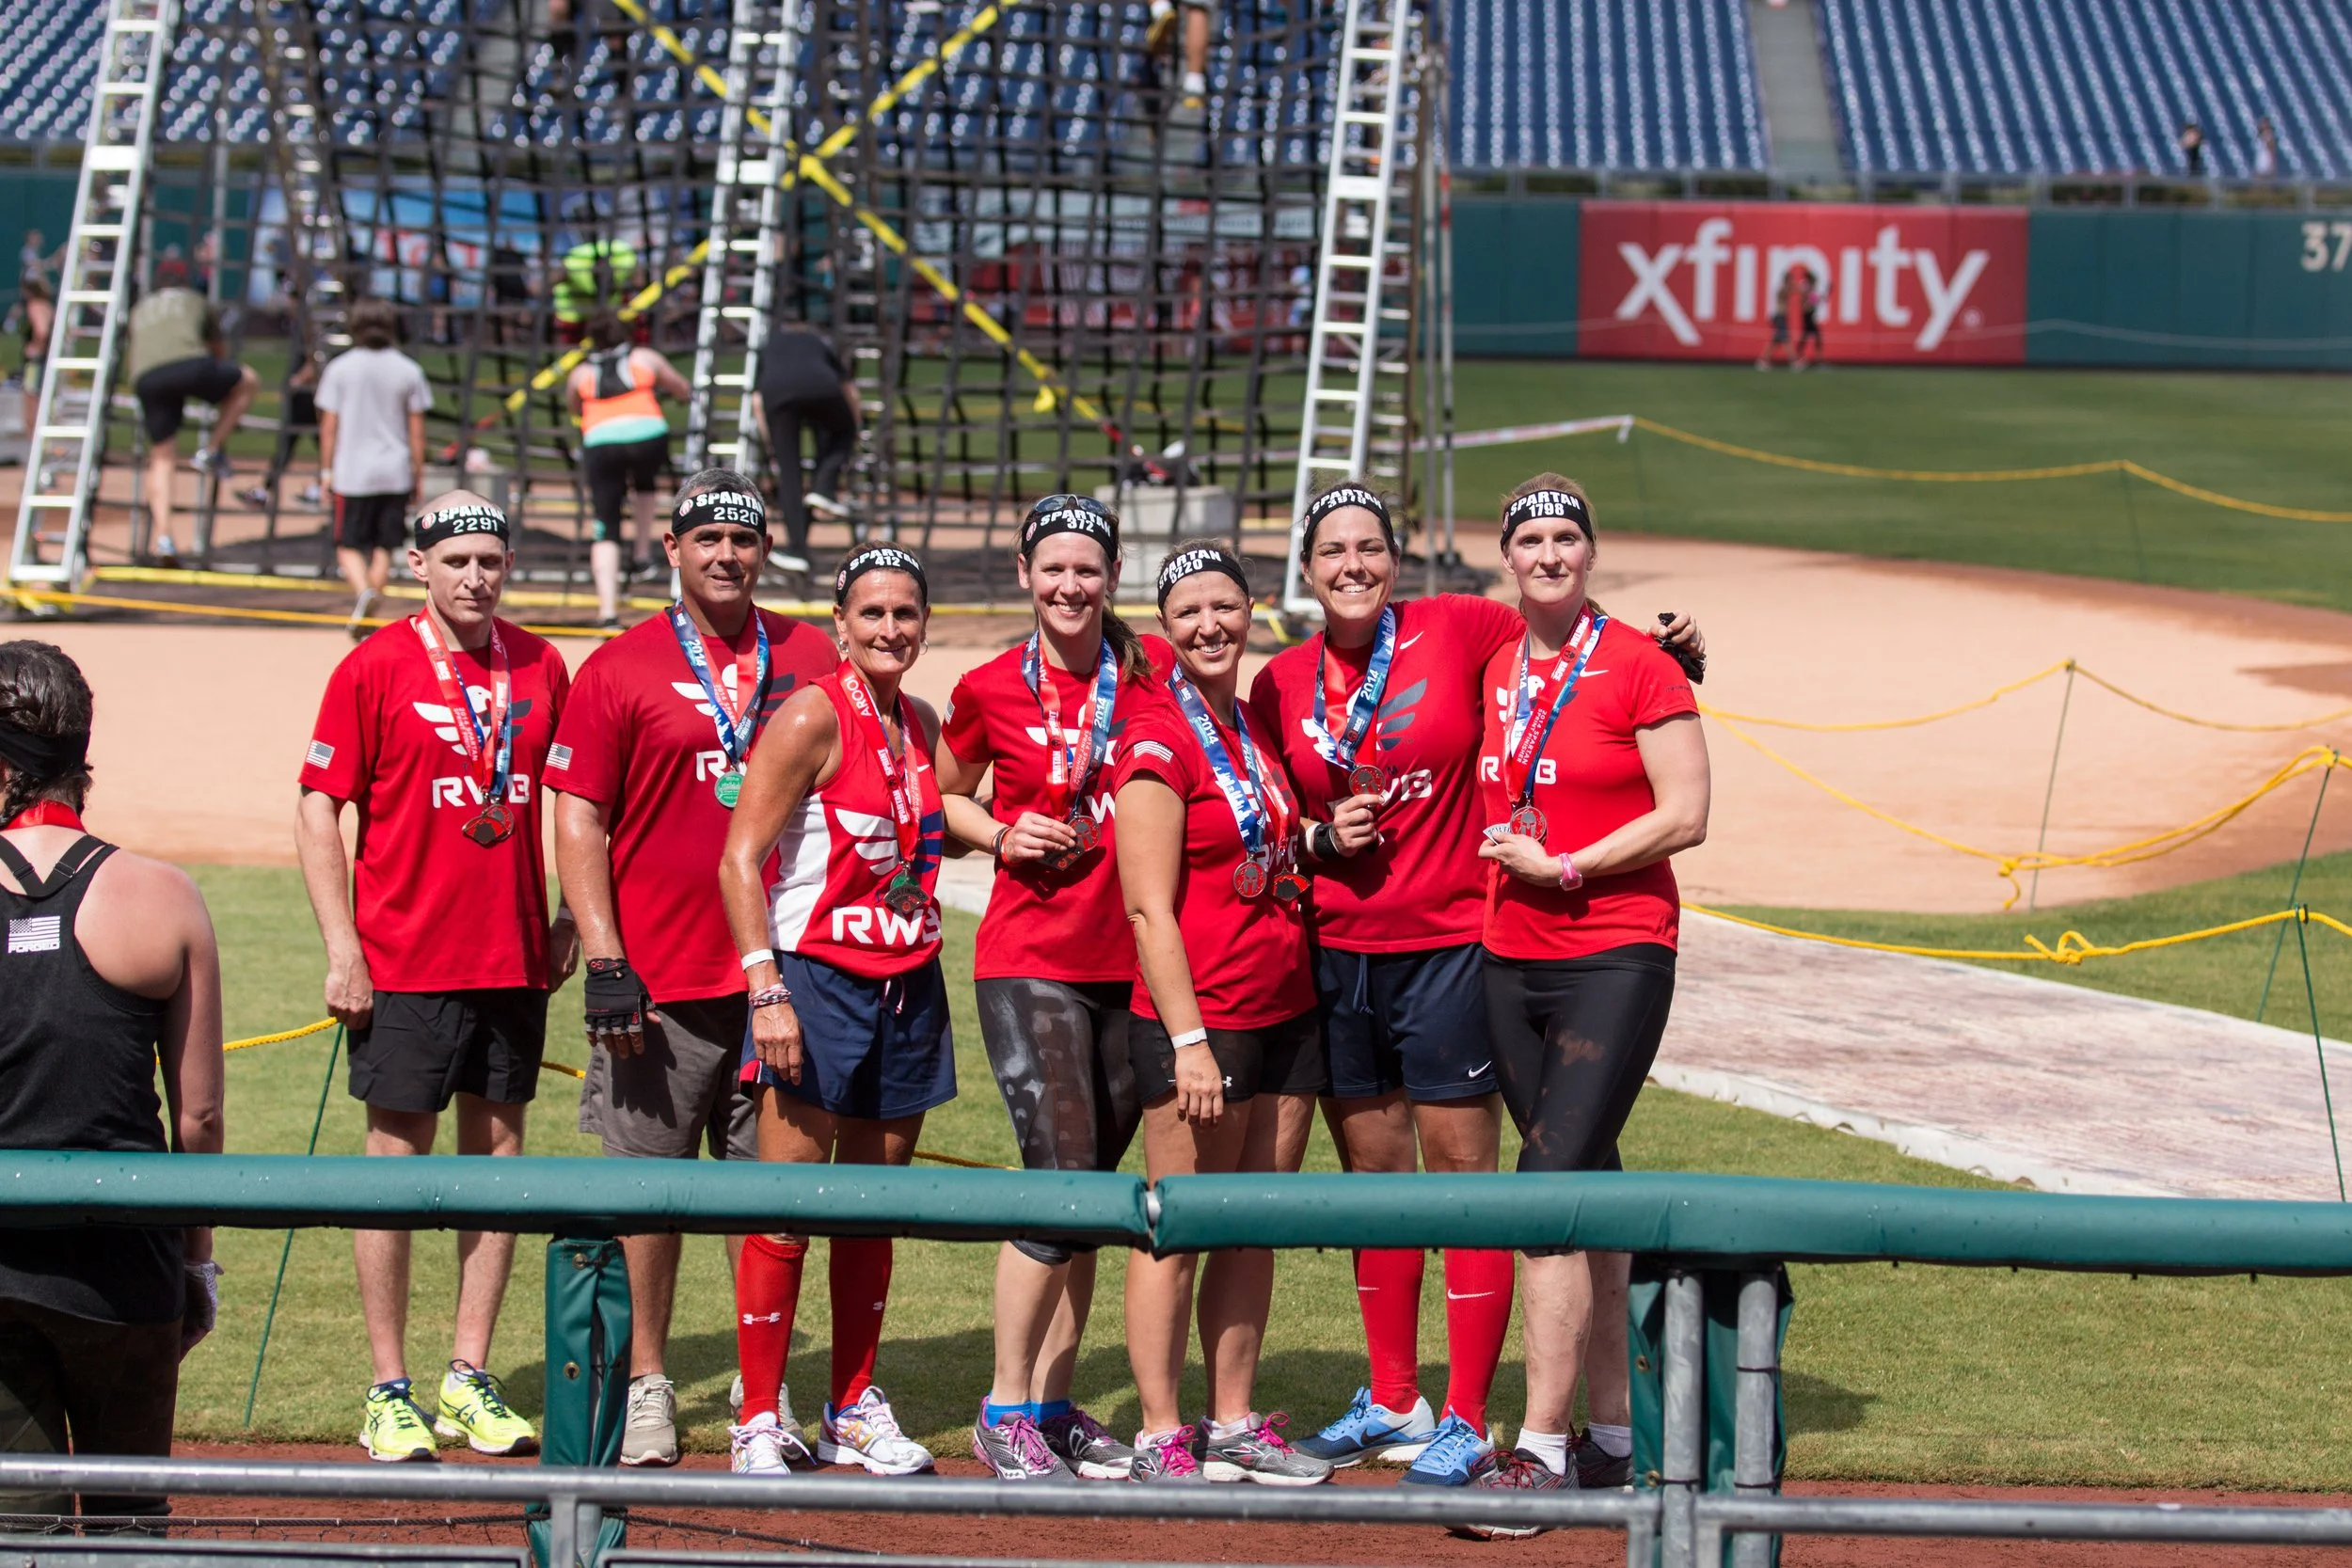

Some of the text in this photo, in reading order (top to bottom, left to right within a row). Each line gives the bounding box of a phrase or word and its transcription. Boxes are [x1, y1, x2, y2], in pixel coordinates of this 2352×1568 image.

[1615, 218, 1990, 351] xfinity
[437, 505, 506, 524] SPARTAN
[1312, 489, 1382, 514] SPARTAN
[1510, 491, 1581, 516] SPARTAN
[1529, 502, 1565, 517] 1798
[453, 517, 498, 533] 2291
[713, 507, 758, 526] 2520
[1040, 509, 1111, 537] SPARTAN
[1067, 517, 1094, 532] 372
[850, 548, 920, 571] SPARTAN
[875, 556, 900, 567] 412
[1158, 549, 1222, 590] SPARTAN
[691, 638, 707, 666] 2014
[1551, 614, 1591, 681] SPARTAN RACE
[1359, 669, 1379, 700] 2014
[1092, 696, 1106, 728] 2014
[1078, 729, 1089, 754] SPRINT
[1198, 713, 1219, 744] 2014
[1517, 707, 1542, 762] SPRINT FINISHER
[1521, 709, 1547, 765] 2014 SPARTAN
[1074, 752, 1088, 785] SPARTAN
[1242, 744, 1253, 769] 2014
[1481, 756, 1556, 784] RB
